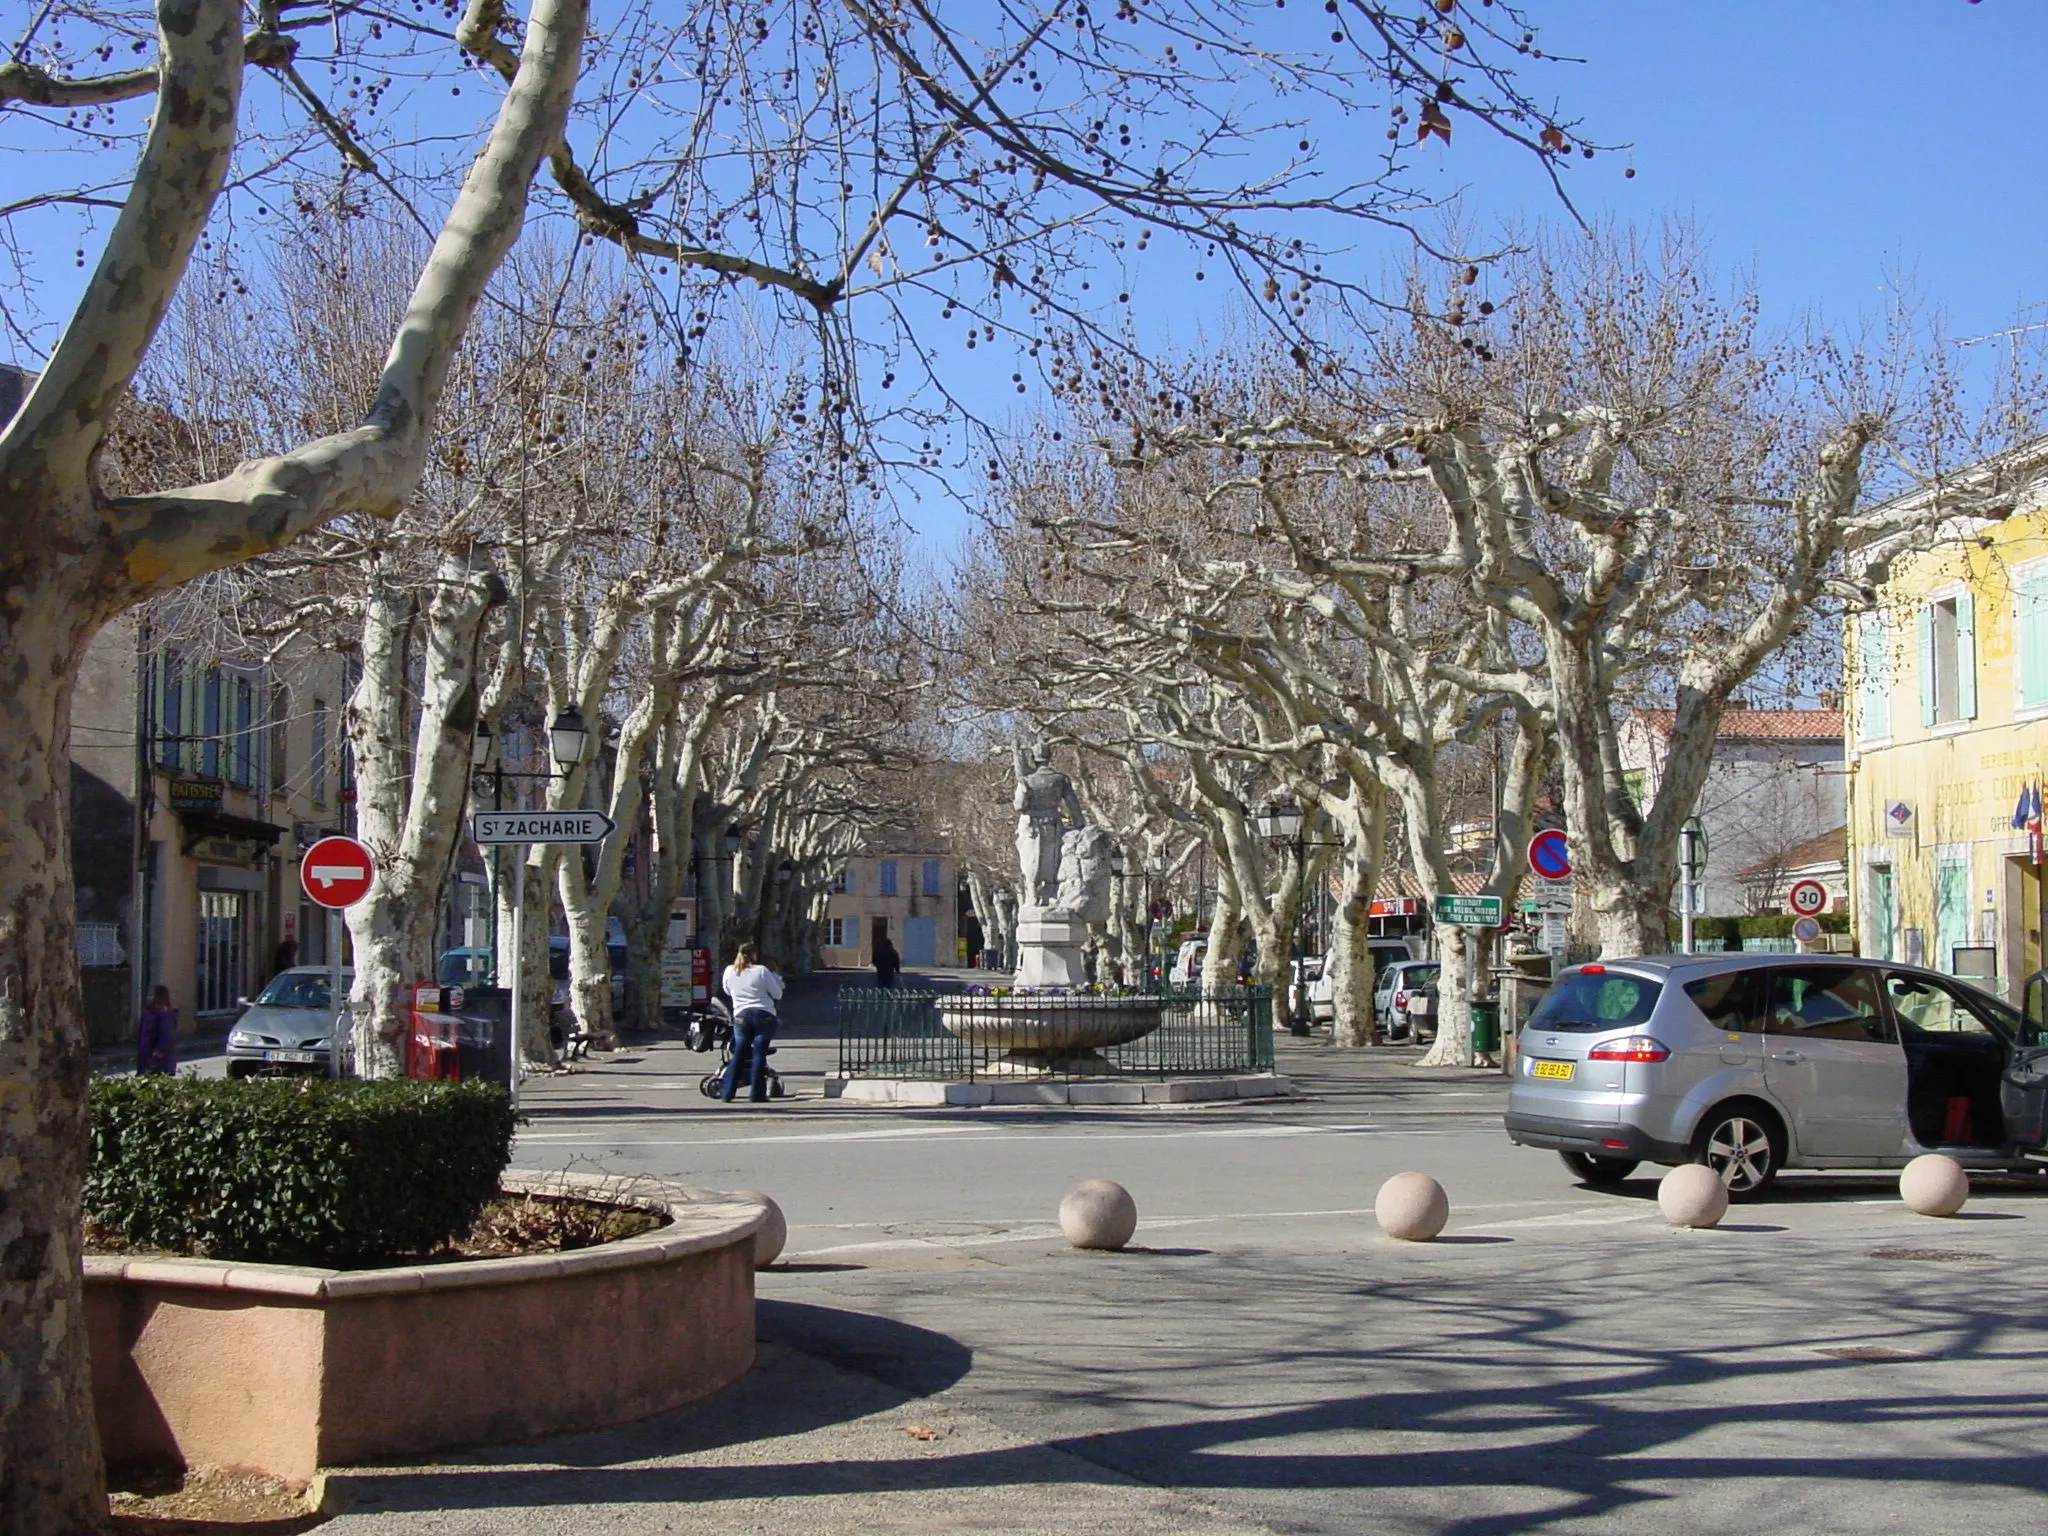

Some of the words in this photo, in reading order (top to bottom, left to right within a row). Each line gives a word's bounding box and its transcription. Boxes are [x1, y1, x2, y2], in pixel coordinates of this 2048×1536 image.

[482, 821, 500, 836] ST
[505, 820, 592, 836] ZACHARIE
[1799, 892, 1818, 904] 30
